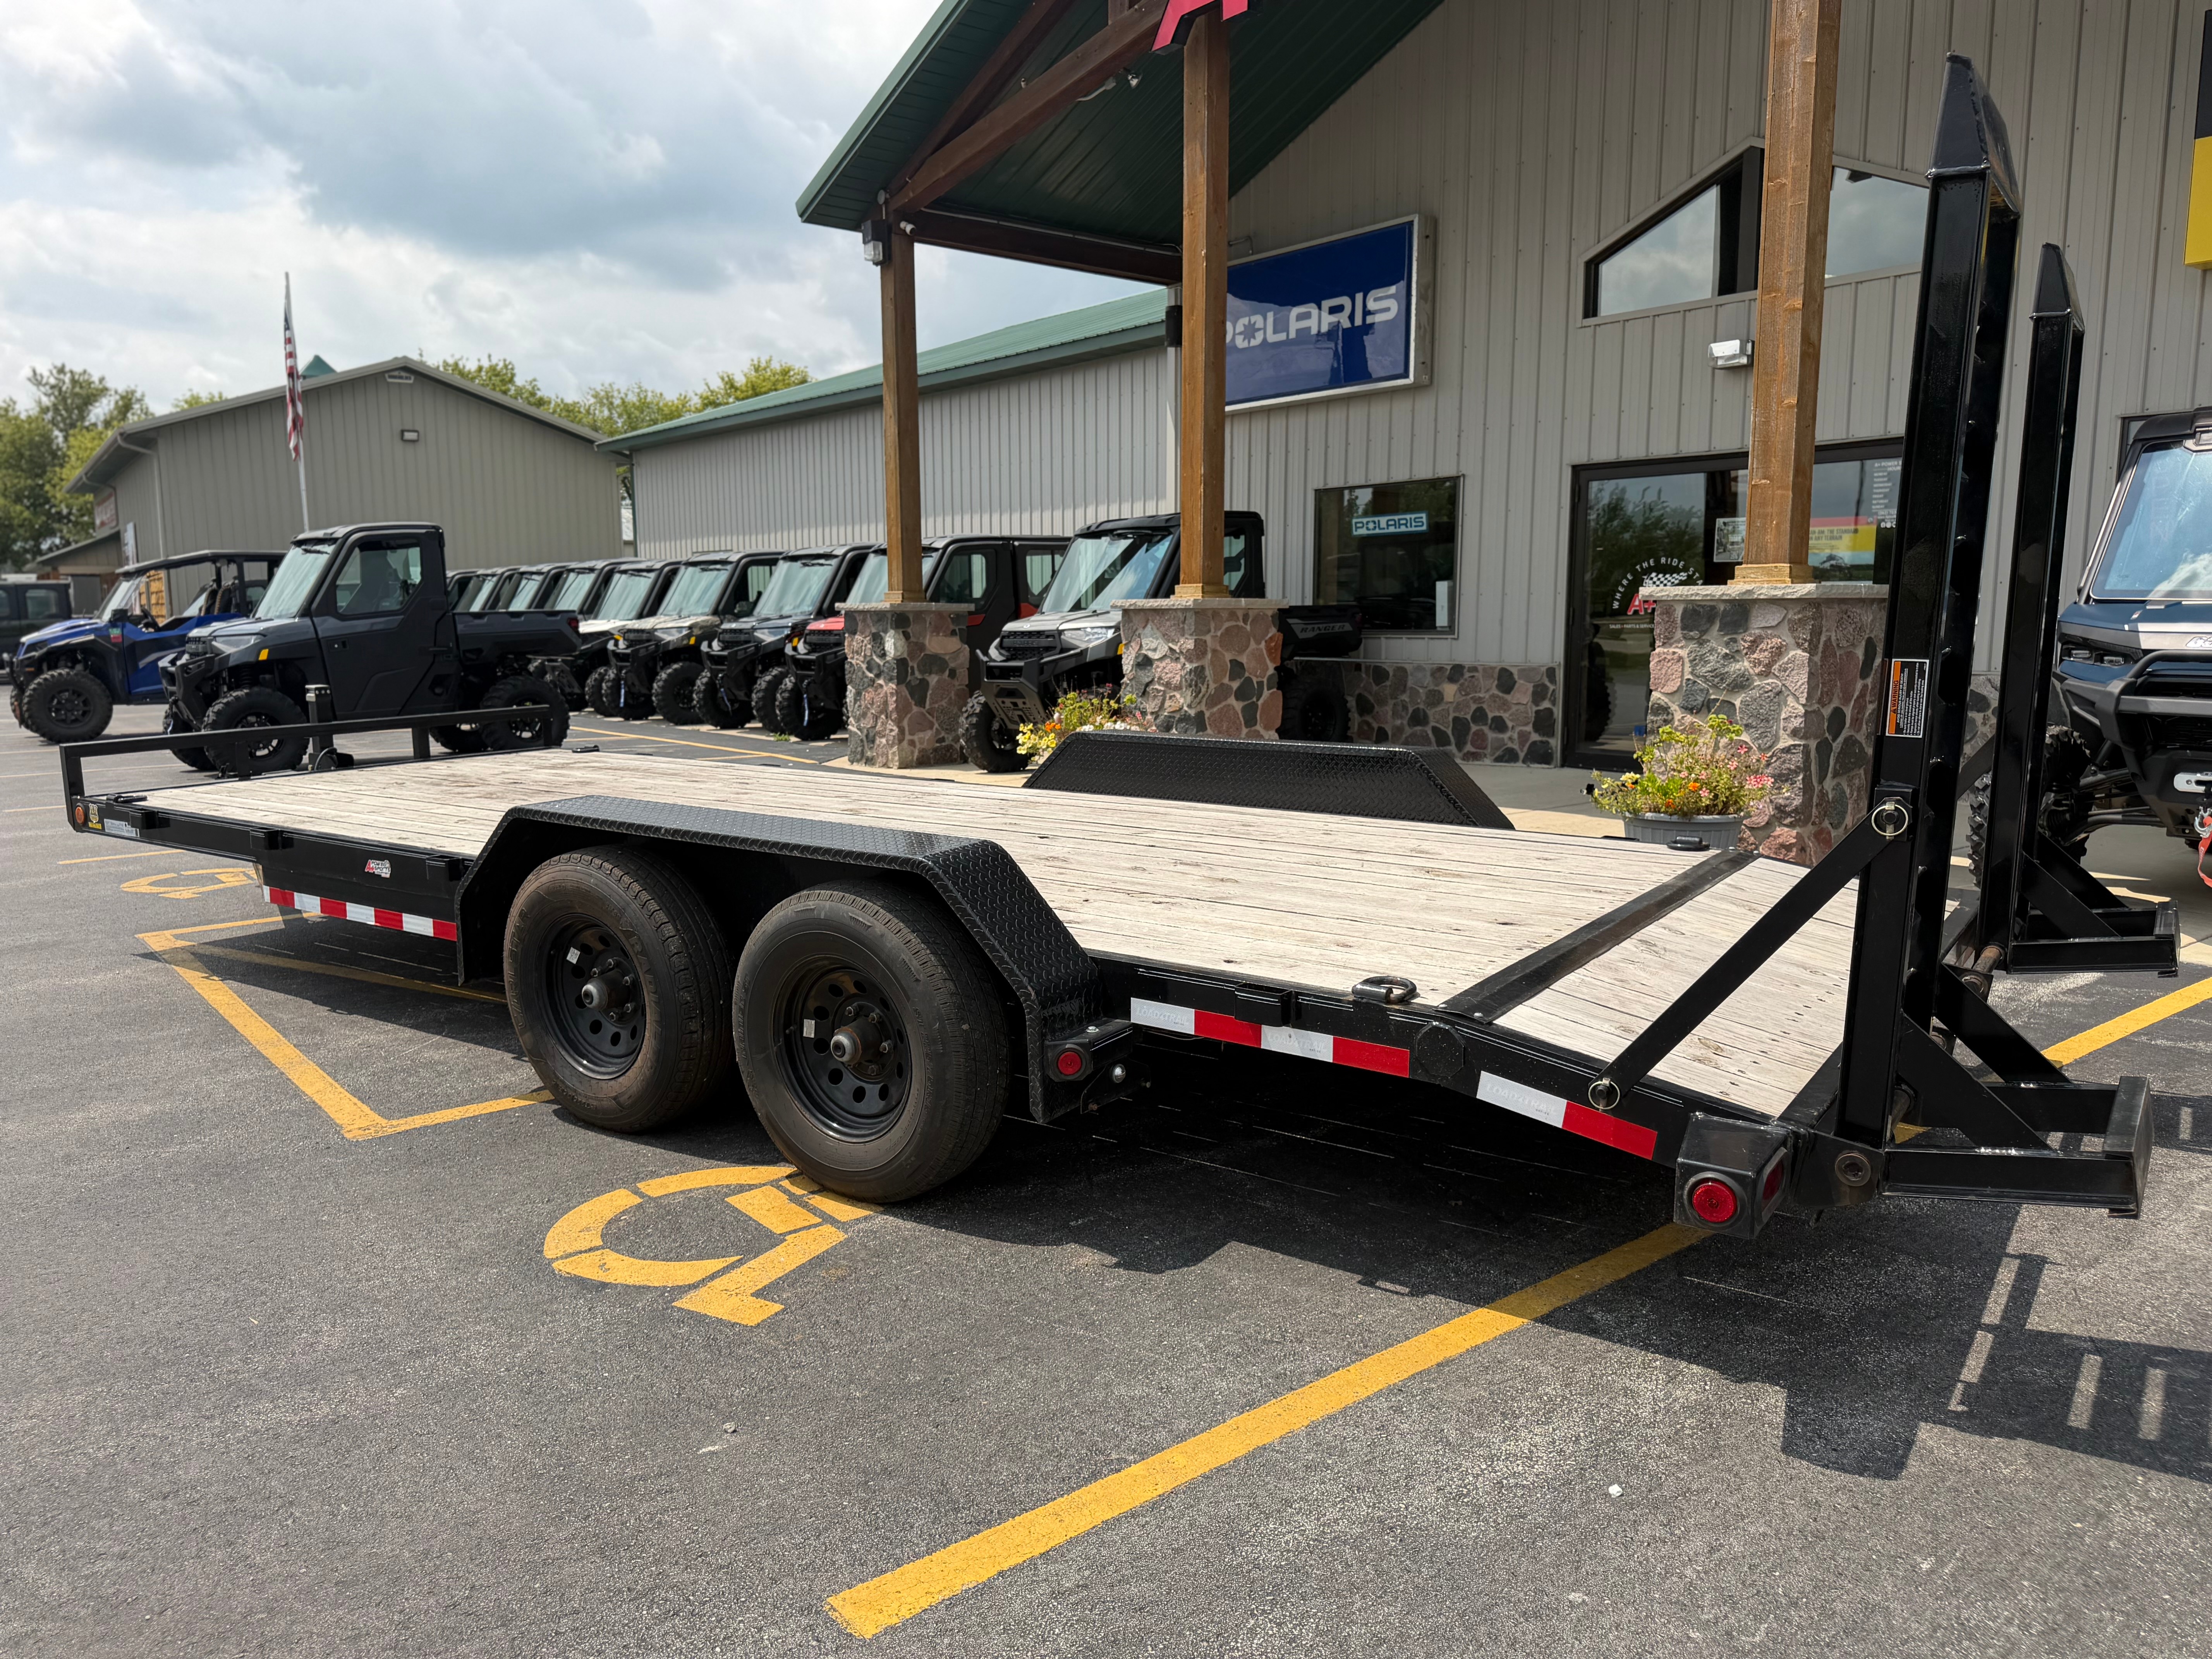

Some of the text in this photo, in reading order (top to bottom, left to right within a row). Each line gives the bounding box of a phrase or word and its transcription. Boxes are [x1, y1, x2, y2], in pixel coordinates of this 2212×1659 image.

[1355, 517, 1424, 532] POLARIS
[1613, 557, 1703, 608] WHERE THE RIDE STA
[1300, 624, 1346, 633] RANGER
[508, 907, 531, 1029] CARLSTAR
[629, 936, 662, 1041] RADIAL
[1136, 1006, 1189, 1025] LOAD TRAIL
[1268, 1034, 1293, 1045] LOAD
[1300, 1039, 1328, 1051] TRAIL
[1486, 1084, 1517, 1101] LOAD
[1525, 1096, 1558, 1115] TRAIL
